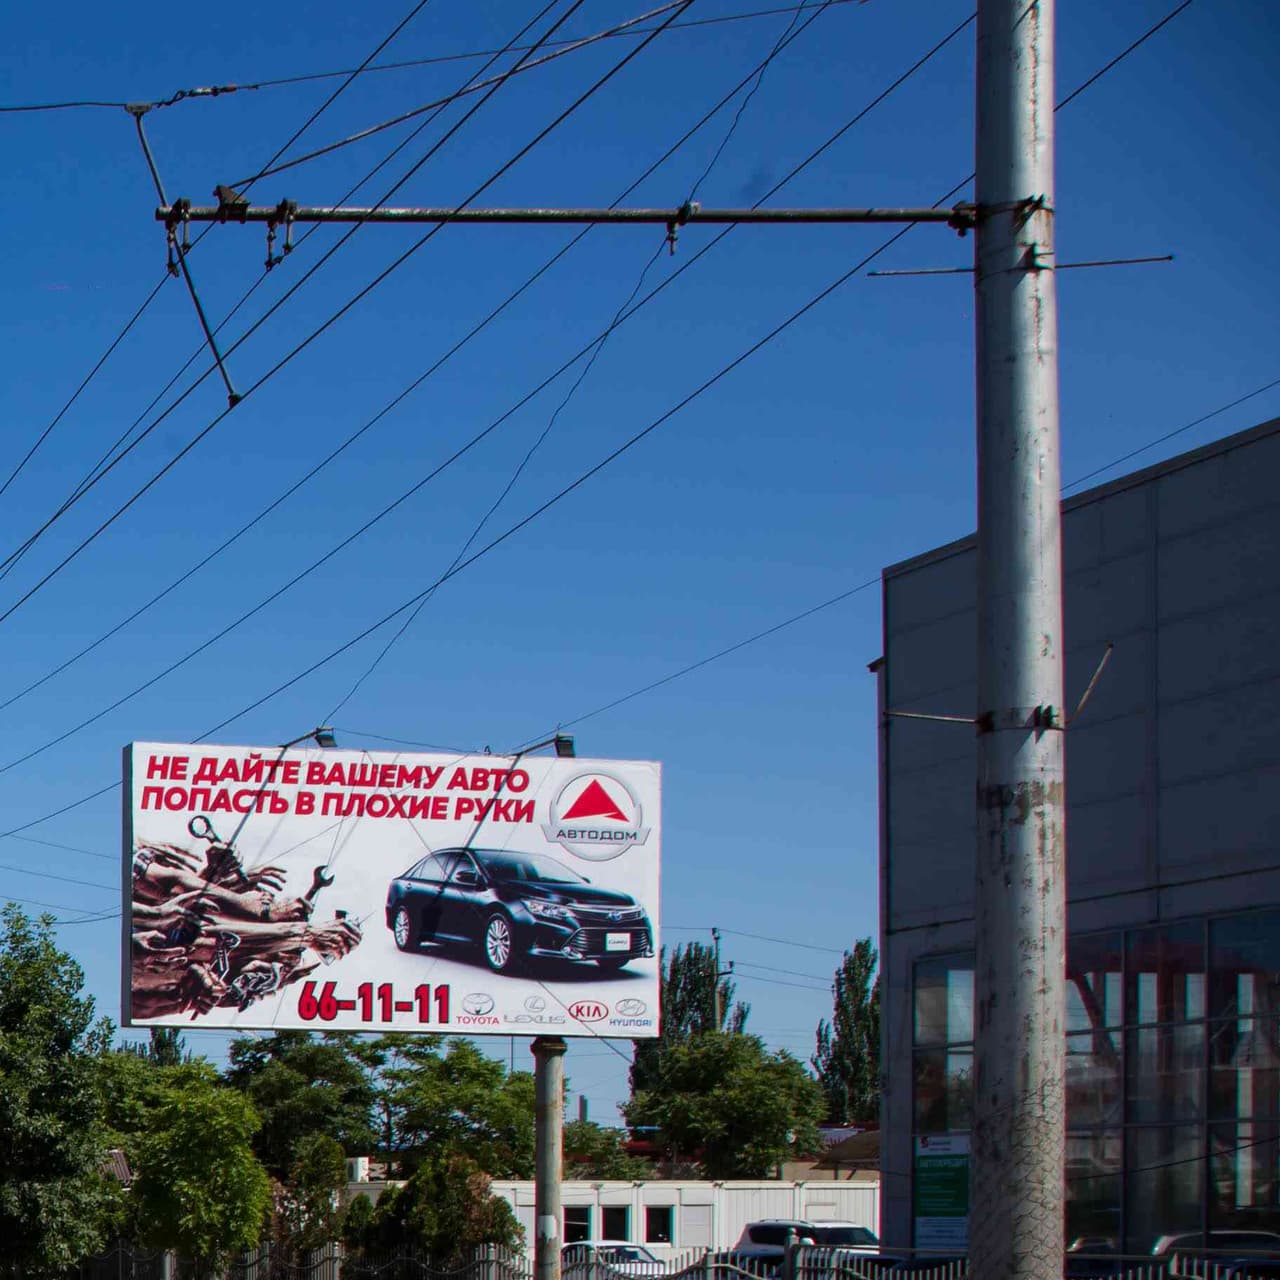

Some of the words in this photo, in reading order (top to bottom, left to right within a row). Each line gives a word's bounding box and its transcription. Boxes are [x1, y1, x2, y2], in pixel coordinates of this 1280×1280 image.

[146, 755, 190, 780] НЕ
[192, 753, 302, 786] ДАЙТЕ
[306, 761, 445, 789] ВАШЕМУ
[447, 767, 530, 793] АВТО
[140, 786, 289, 814] ПОПАСТЬ
[295, 791, 316, 816] В
[321, 792, 449, 820] ПЛОХИЕ
[454, 797, 536, 824] РУКИ
[556, 829, 638, 841] АВТОДОМ
[298, 981, 450, 1024] 66-11-11
[575, 1005, 601, 1018] KIA
[456, 1015, 500, 1025] TOYOTA
[504, 1014, 566, 1025] LEXUS
[609, 1018, 652, 1028] HYUNDAI
